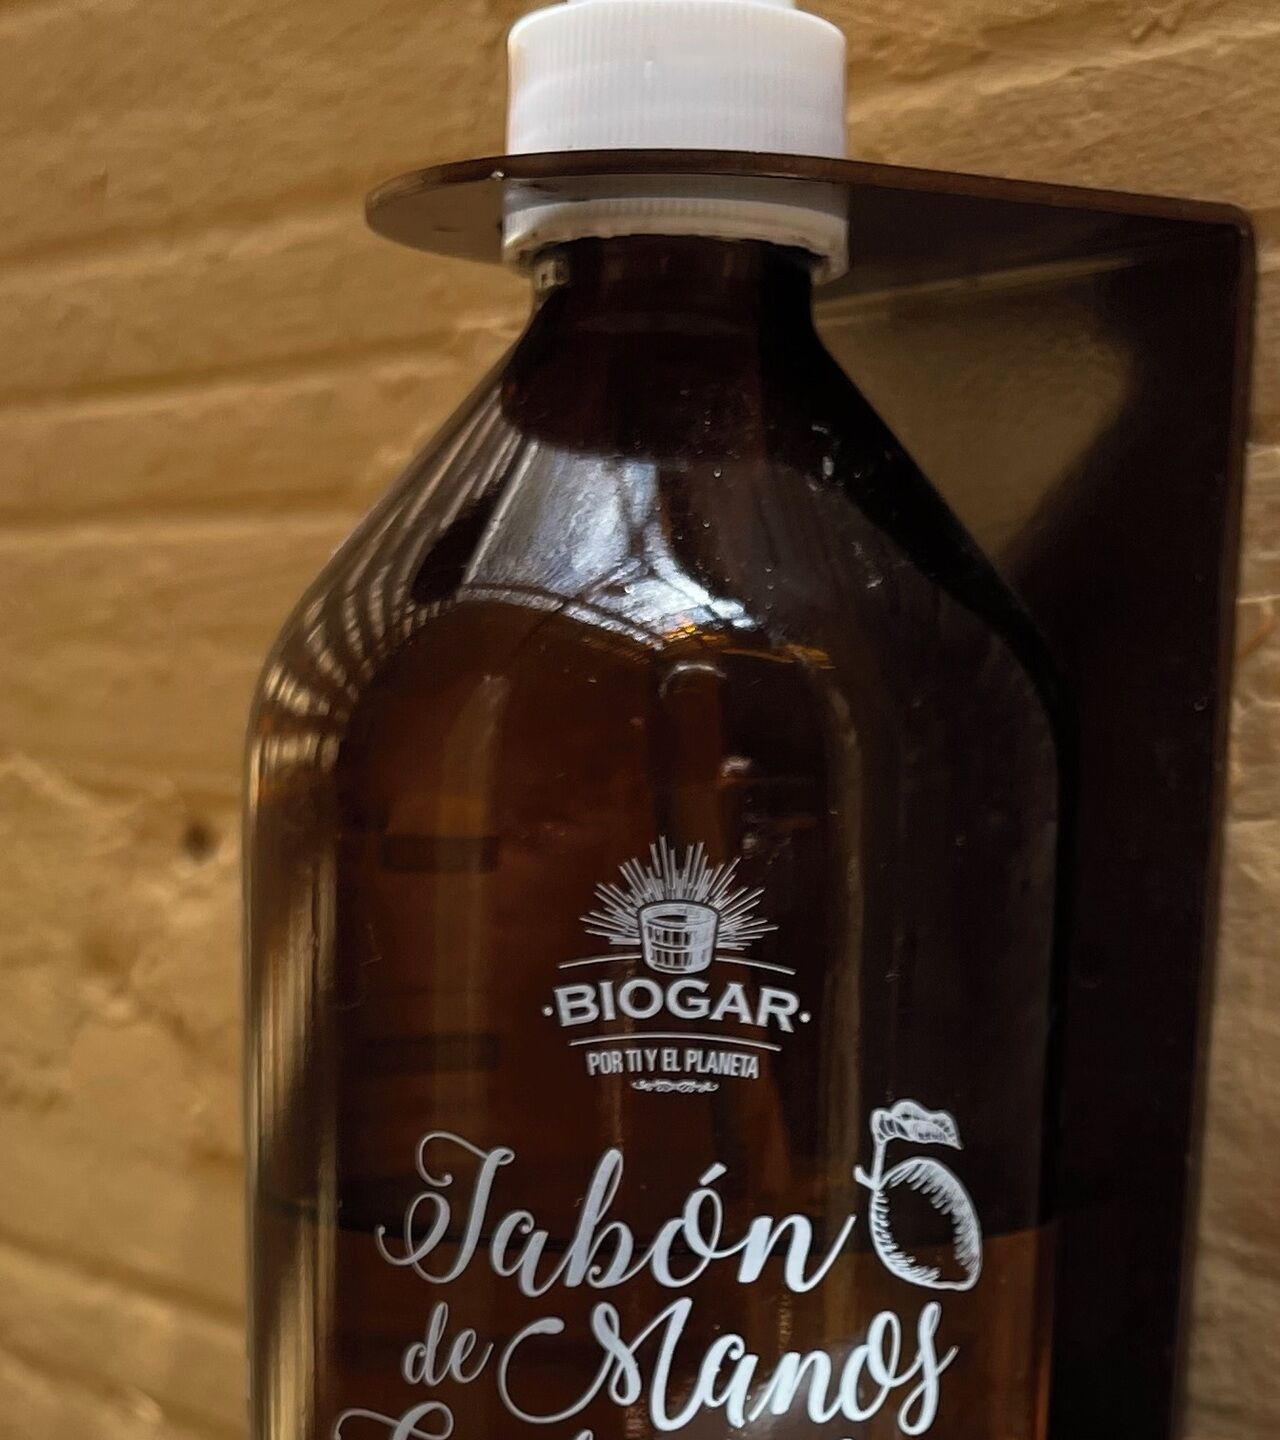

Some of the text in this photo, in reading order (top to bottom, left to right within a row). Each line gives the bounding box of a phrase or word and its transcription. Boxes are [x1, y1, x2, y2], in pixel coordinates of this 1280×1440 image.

[553, 978, 802, 1033] BIOGAR
[586, 1050, 759, 1080] POR TI Y EL PLANETA
[402, 1297, 960, 1436] de Manos
